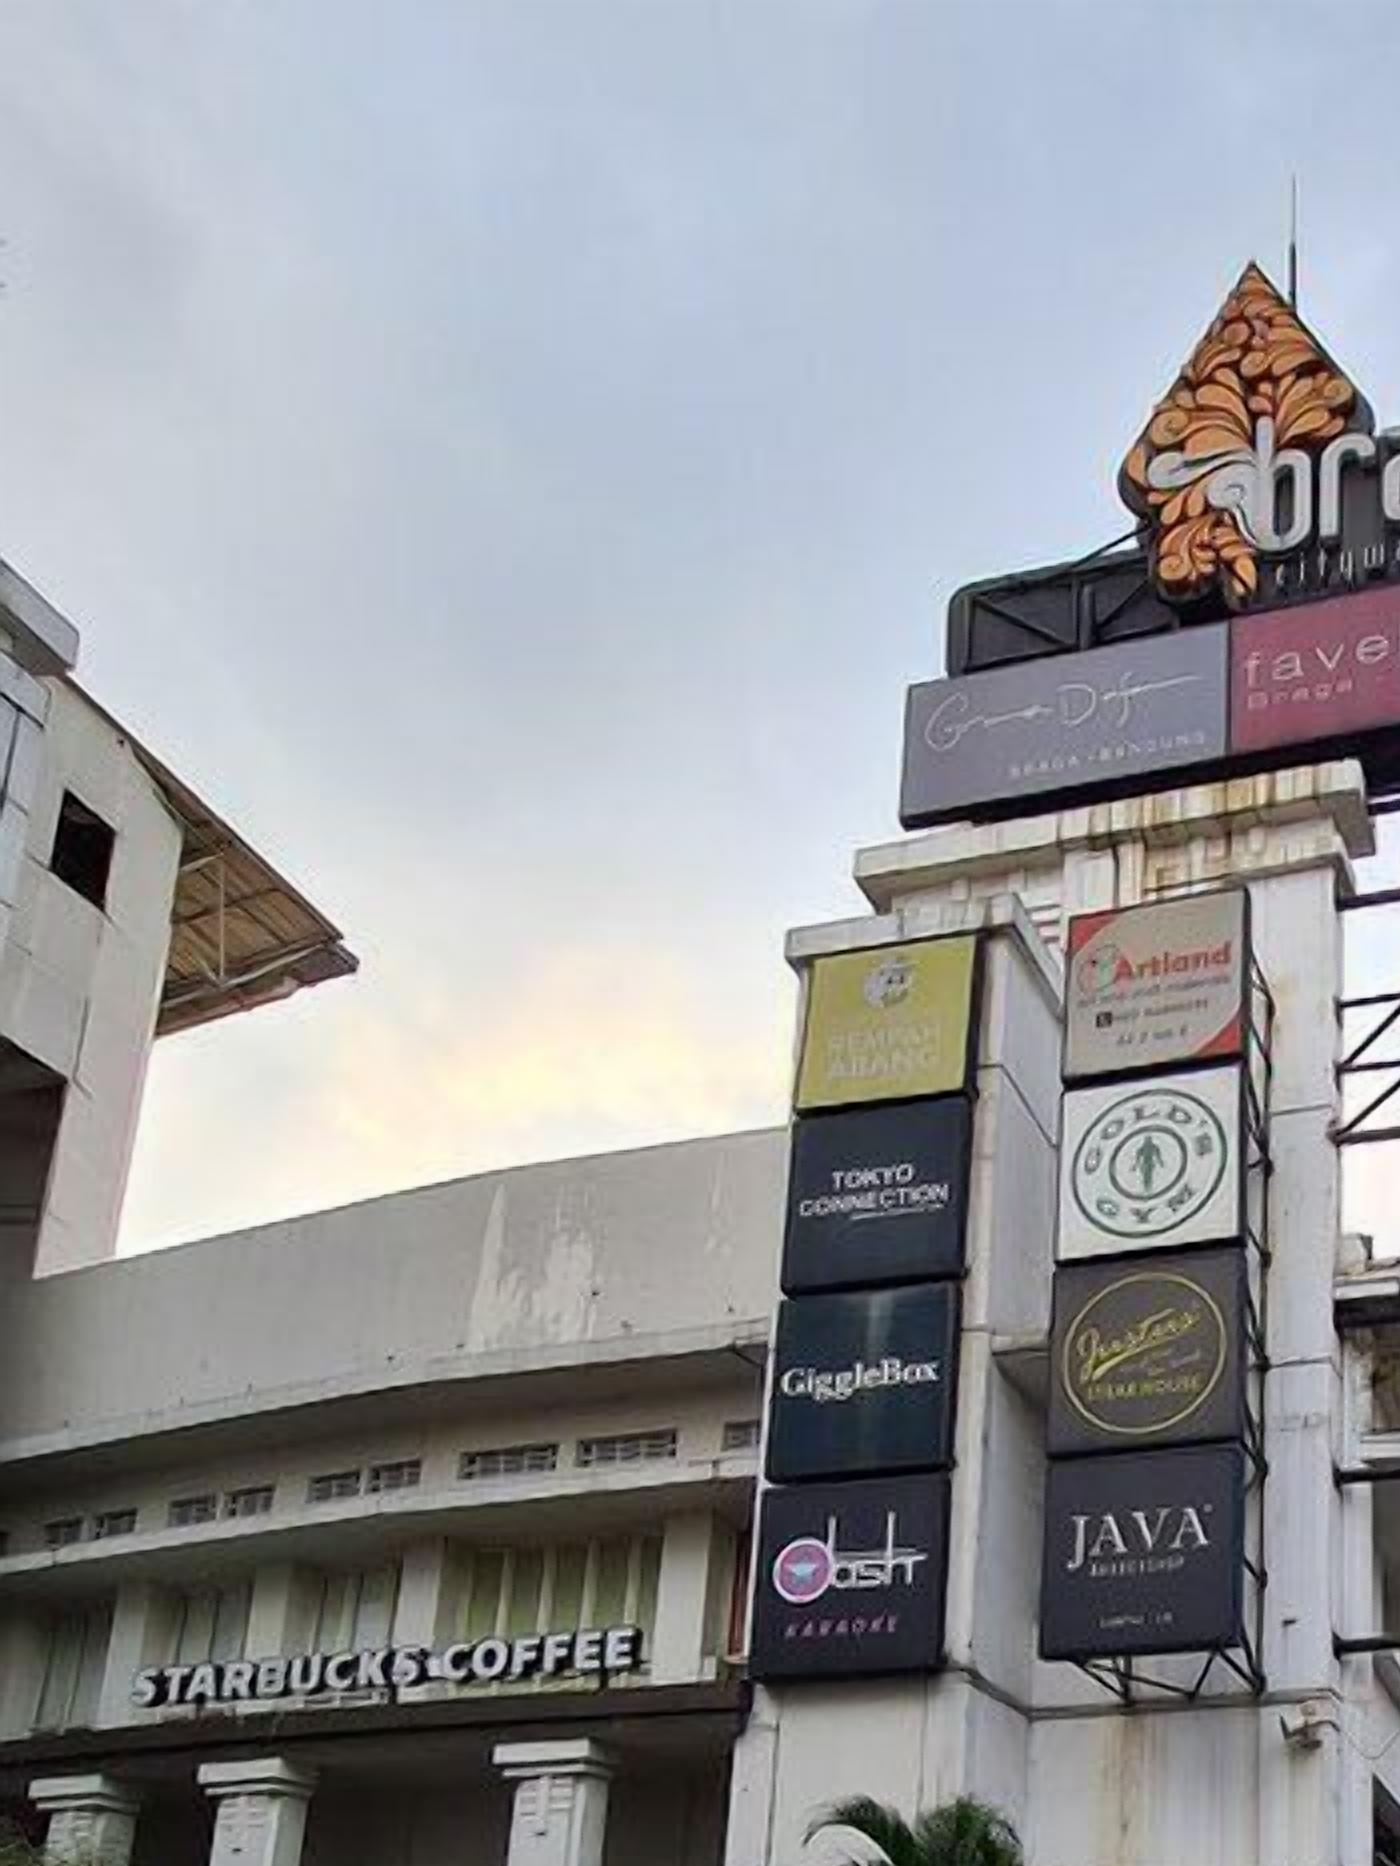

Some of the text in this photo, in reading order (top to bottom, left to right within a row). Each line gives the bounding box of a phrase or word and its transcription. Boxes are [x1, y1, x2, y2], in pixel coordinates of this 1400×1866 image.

[1247, 680, 1352, 710] Braga
[1113, 941, 1233, 979] Artland
[1084, 1104, 1213, 1176] GOLD'S
[831, 1162, 915, 1189] TOKYO
[798, 1184, 950, 1218] CONNECTION
[1096, 1184, 1197, 1225] GYM
[780, 1357, 939, 1402] GiggleBox
[1067, 1506, 1210, 1571] JAVA
[130, 1626, 638, 1708] STARBUCKS COFFEE
